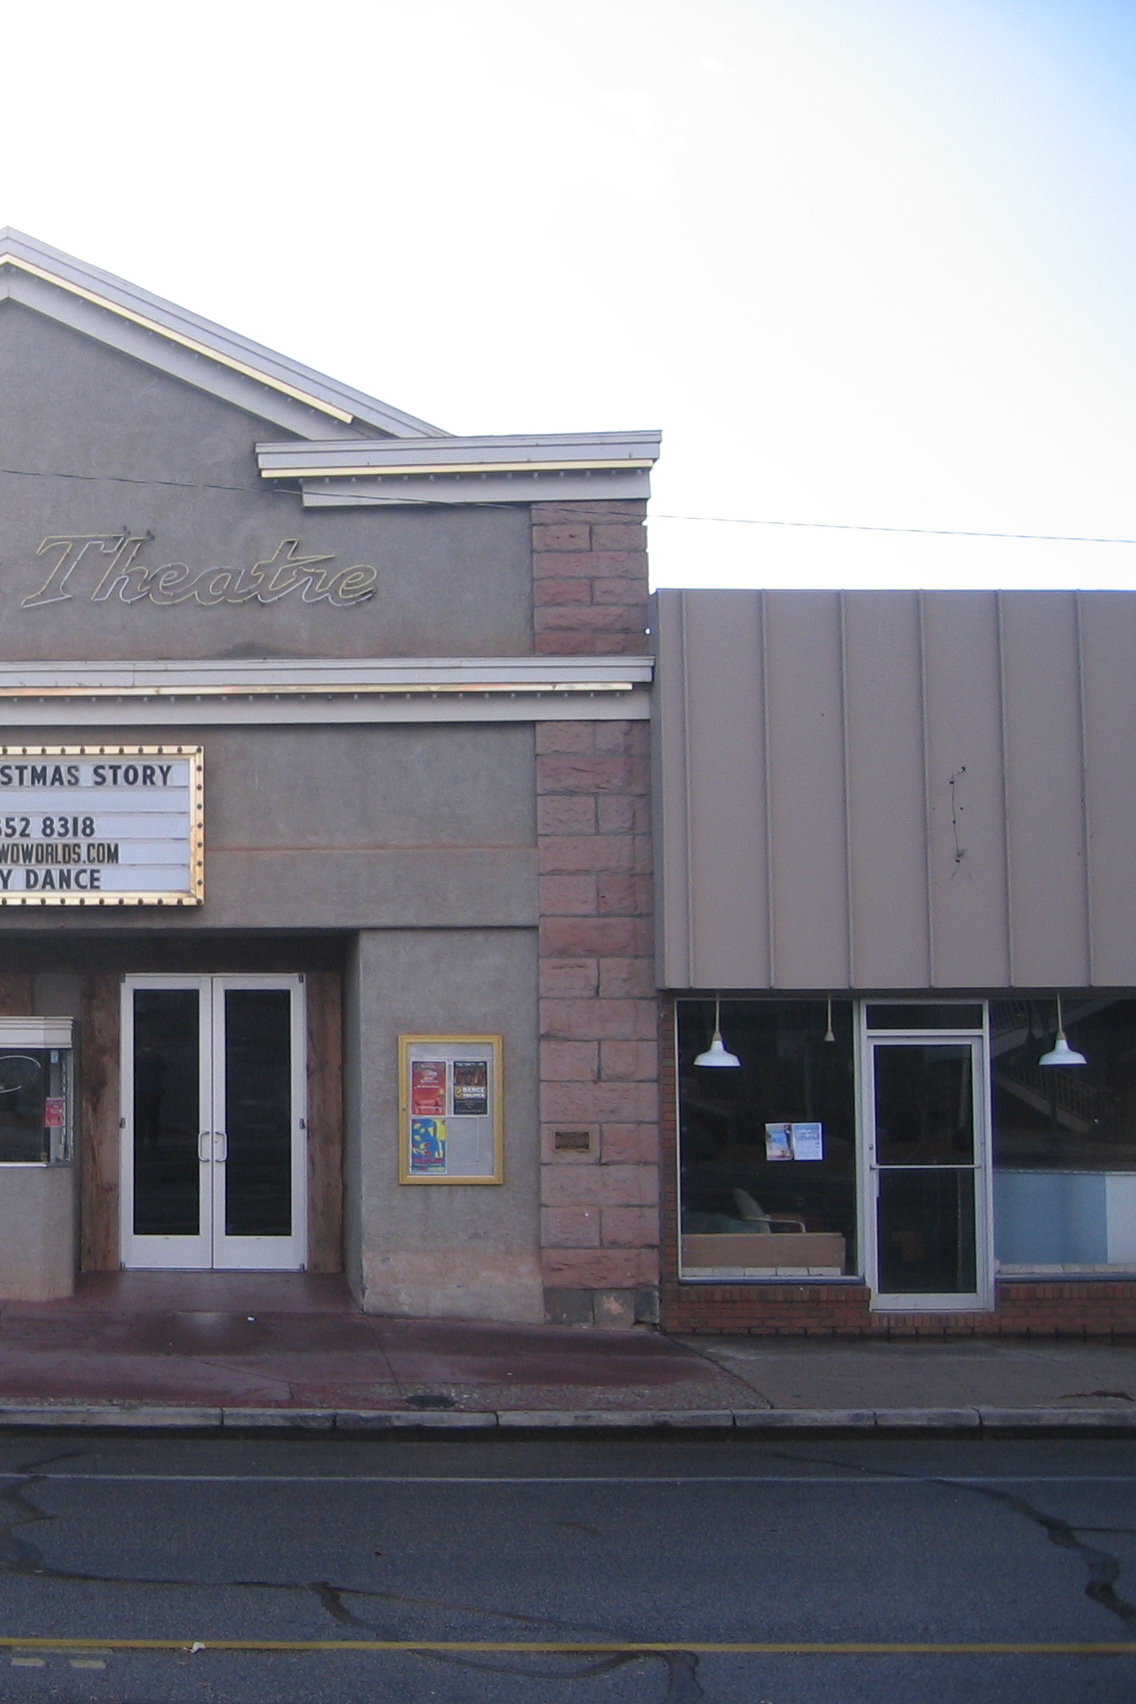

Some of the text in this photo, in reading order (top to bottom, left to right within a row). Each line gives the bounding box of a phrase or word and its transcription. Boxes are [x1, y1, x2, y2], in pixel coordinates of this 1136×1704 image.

[21, 532, 377, 608] Theatre
[93, 765, 172, 786] STORY
[41, 816, 95, 838] 8318
[25, 869, 101, 890] DANCE
